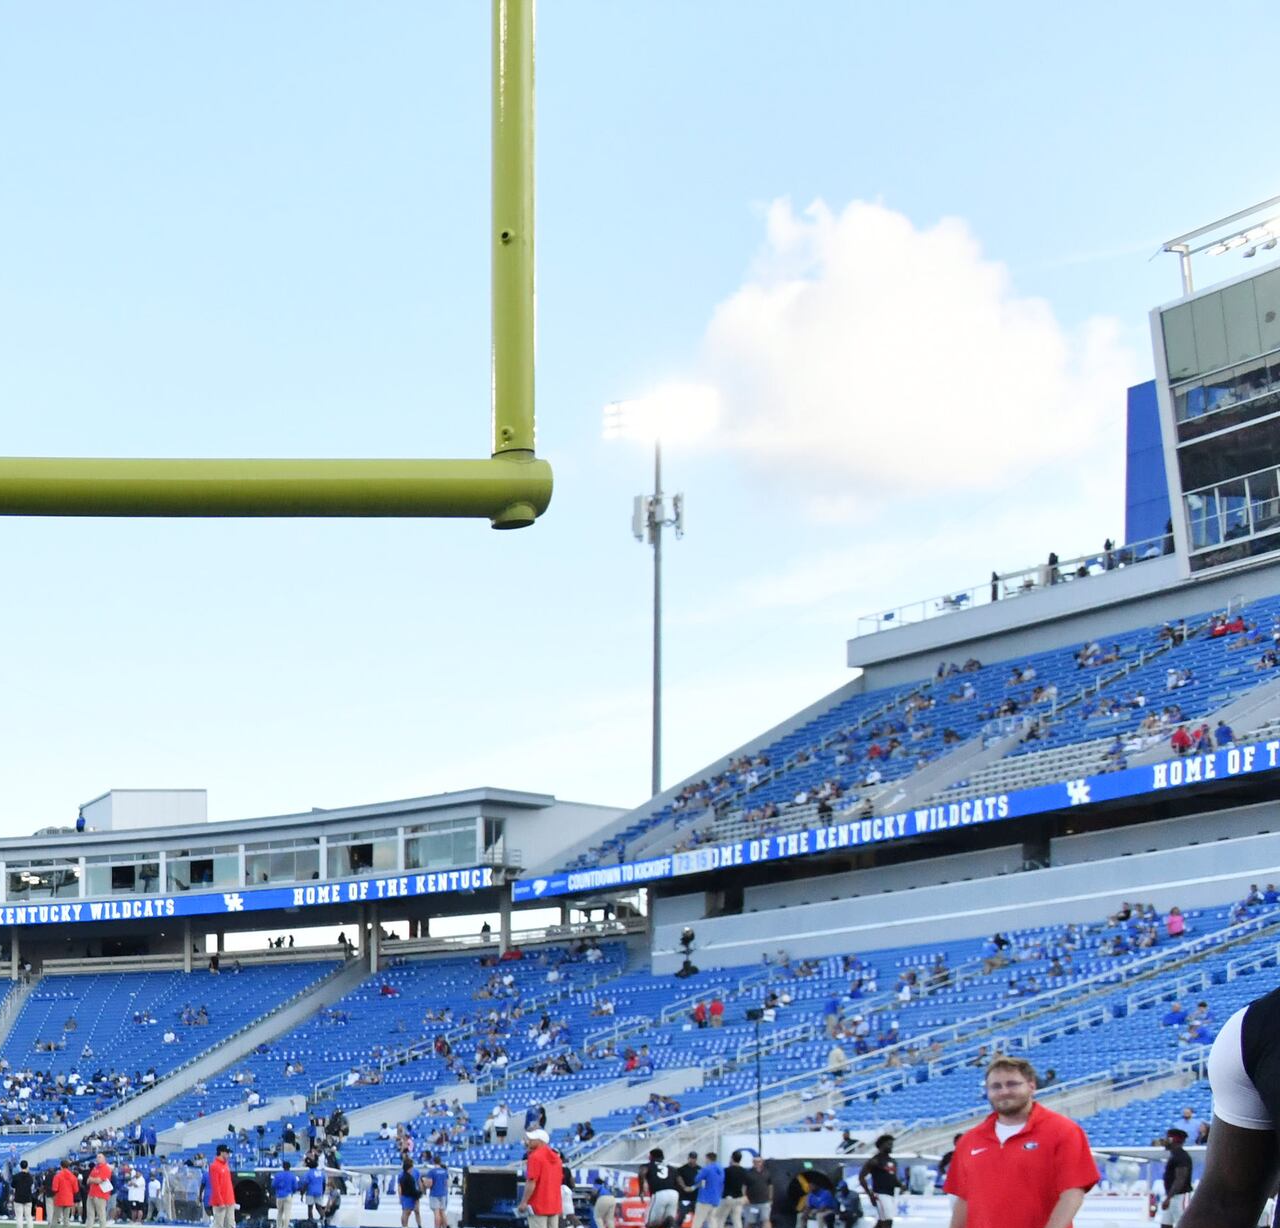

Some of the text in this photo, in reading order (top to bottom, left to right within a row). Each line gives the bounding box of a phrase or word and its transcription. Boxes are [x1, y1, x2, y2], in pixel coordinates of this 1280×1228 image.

[1153, 754, 1215, 789] HOME
[1227, 746, 1256, 775] OF
[750, 840, 770, 861] OF
[776, 832, 809, 857] THE
[816, 814, 907, 850] KENTUCKY
[914, 795, 1009, 832] WILDCATS
[567, 868, 620, 891] COUNTDOWN
[622, 865, 633, 880] TO
[633, 858, 671, 879] KICKOFF
[293, 885, 340, 906] HOME
[348, 881, 369, 900] OF
[376, 878, 408, 898] THE
[90, 899, 175, 920] WILDCATS
[656, 1163, 669, 1179] 3
